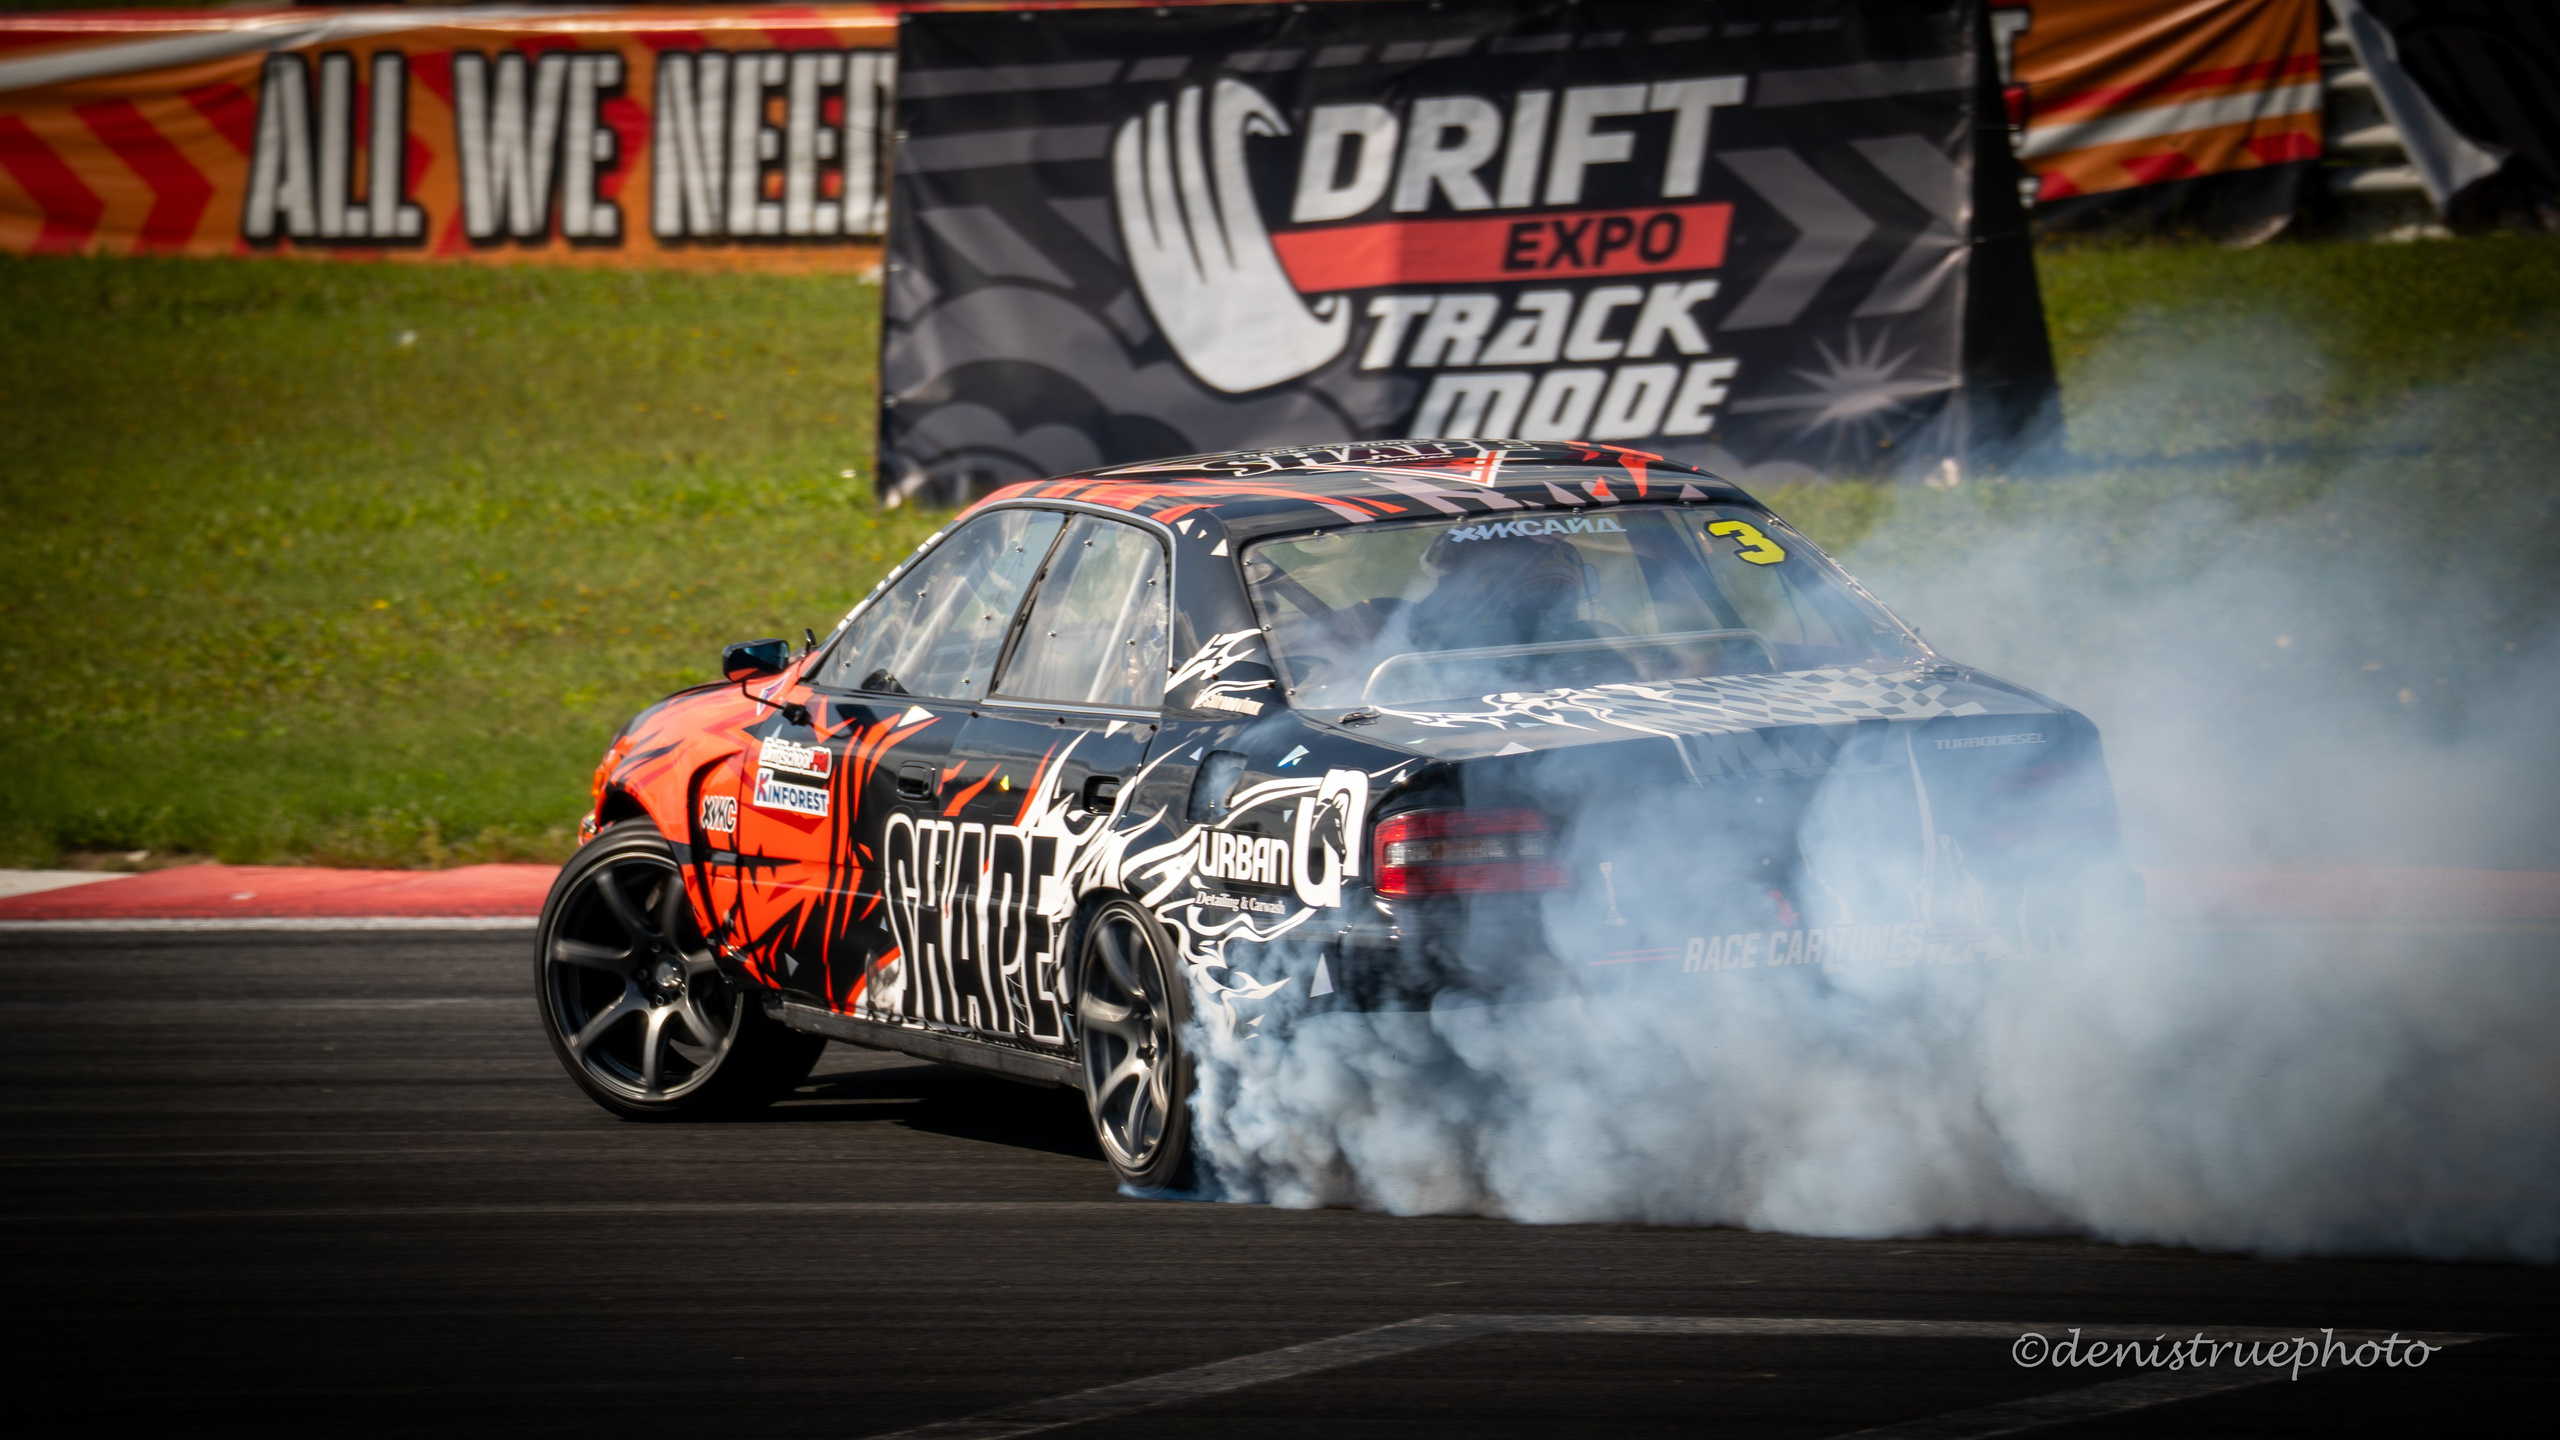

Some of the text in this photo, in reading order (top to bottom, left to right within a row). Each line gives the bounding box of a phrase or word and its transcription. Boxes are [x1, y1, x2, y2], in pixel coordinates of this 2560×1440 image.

[244, 52, 427, 244] ALL
[454, 52, 624, 244] WE
[1290, 75, 1748, 224] DRIFT
[1501, 213, 1683, 273] EXPO
[1359, 279, 1721, 371] TRACK
[1410, 359, 1740, 441] MODE
[1200, 439, 1541, 477] SHAPE
[1704, 518, 1789, 565] 3
[1934, 733, 2047, 750] TURBODIESEL
[755, 771, 828, 813] KINFOREST
[1198, 830, 1290, 886] URBAN
[884, 812, 1065, 1046] SHAPE
[1195, 890, 1286, 914] Detailing & Carwash
[1683, 932, 1761, 974] RACE
[1766, 928, 1825, 967] CAR
